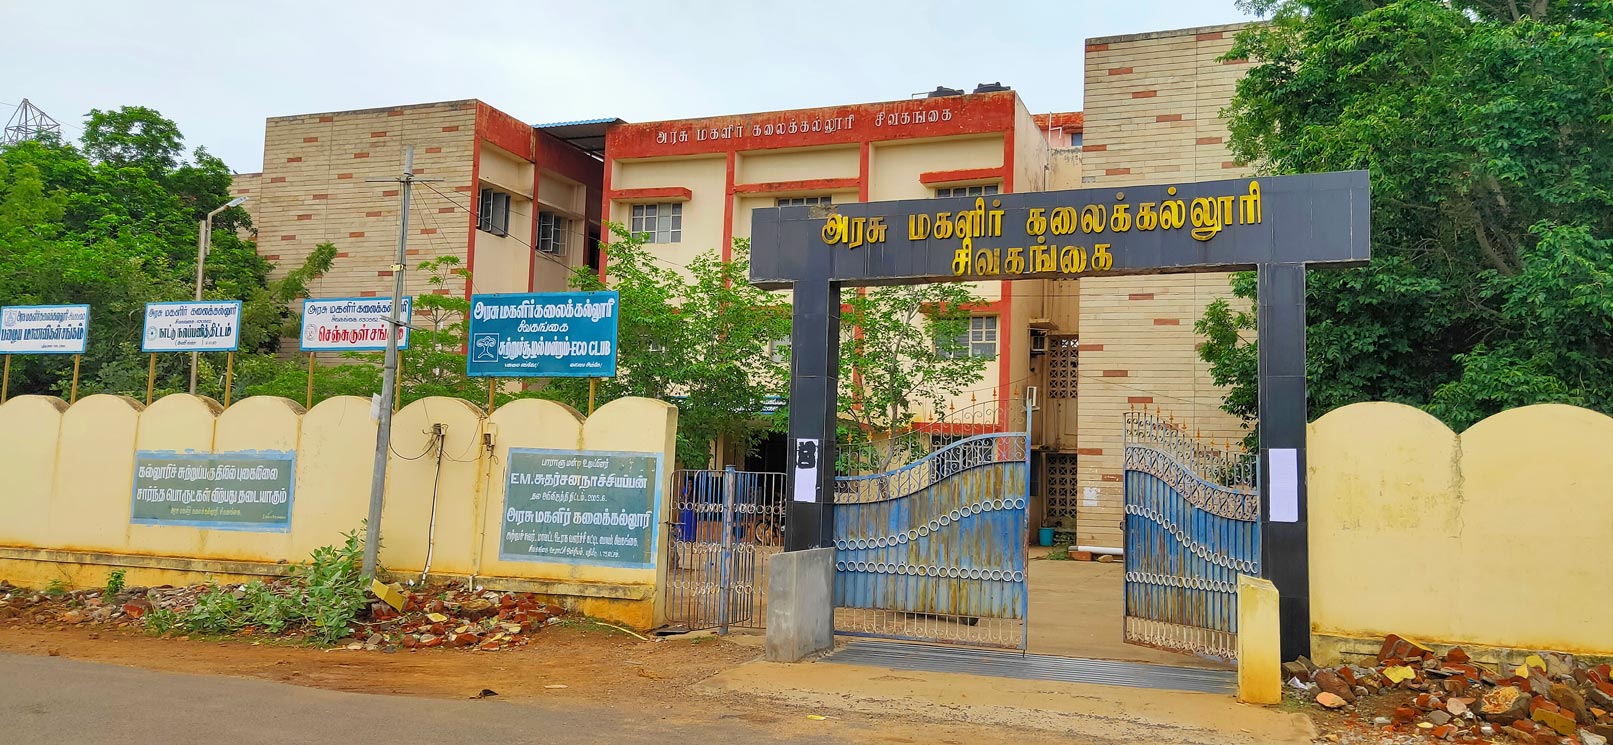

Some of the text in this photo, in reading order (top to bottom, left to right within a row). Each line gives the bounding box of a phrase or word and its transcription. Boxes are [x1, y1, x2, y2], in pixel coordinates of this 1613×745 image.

[656, 108, 952, 144] அரசு மகளிர் கலைக்கல்லூரி சிவகங்கை
[821, 180, 1262, 249] அரசு மகளிர் கலைக்கல்லூரி
[950, 236, 1114, 277] சிவகங்கை
[307, 304, 328, 316] அரசு
[329, 301, 356, 314] மகளிர்
[473, 297, 616, 323] அரசு மகளிர் கலைக்கல்லூரி
[517, 319, 569, 333] சிவகங்கை
[588, 340, 611, 356] CLUB
[136, 485, 166, 503] சார்ந்த
[507, 507, 653, 530] அரசு மகளிர் கலைக்கல்லூரி
